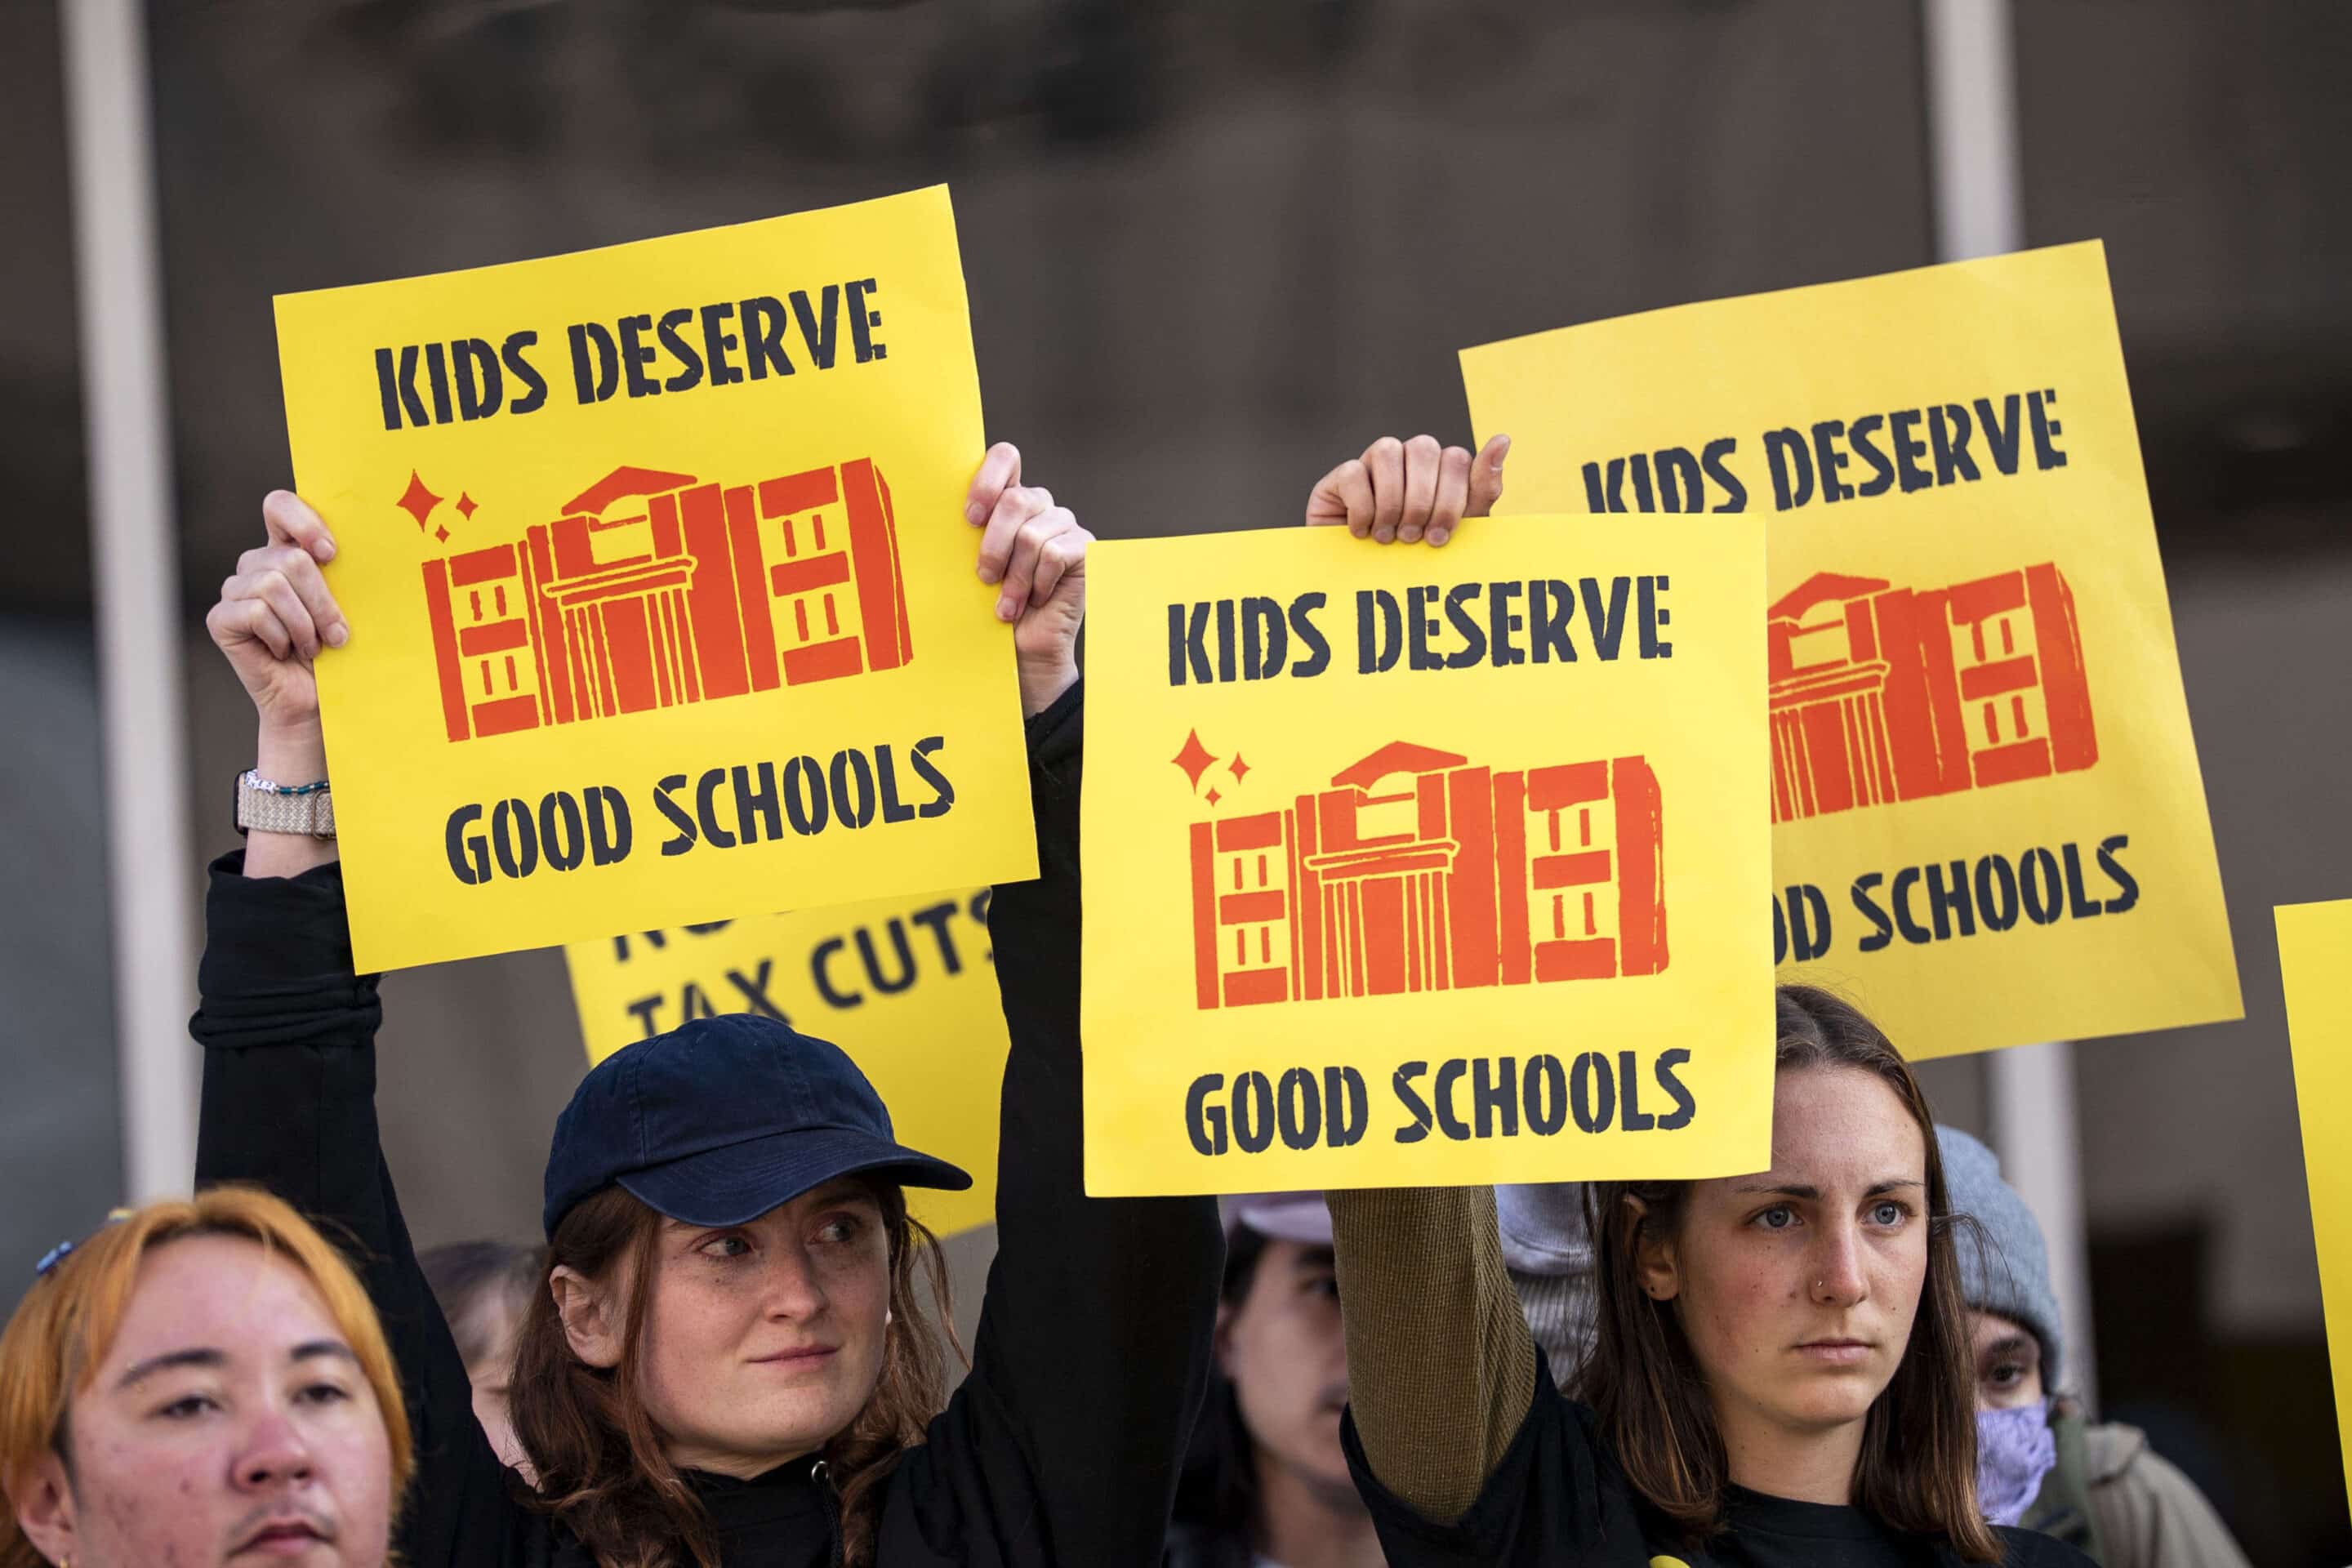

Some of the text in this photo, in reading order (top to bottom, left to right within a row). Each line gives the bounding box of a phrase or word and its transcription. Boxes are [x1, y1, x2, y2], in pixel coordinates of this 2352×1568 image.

[375, 278, 887, 430] KIDS DESERVE
[1582, 389, 2067, 514] KIDS DESERVE
[1168, 576, 1673, 687] KIDS DESERVE
[445, 736, 955, 885] GOOD SCHOOLS
[1851, 835, 2140, 952] SCHOOLS
[1185, 1049, 1696, 1156] GOOD SCHOOLS
